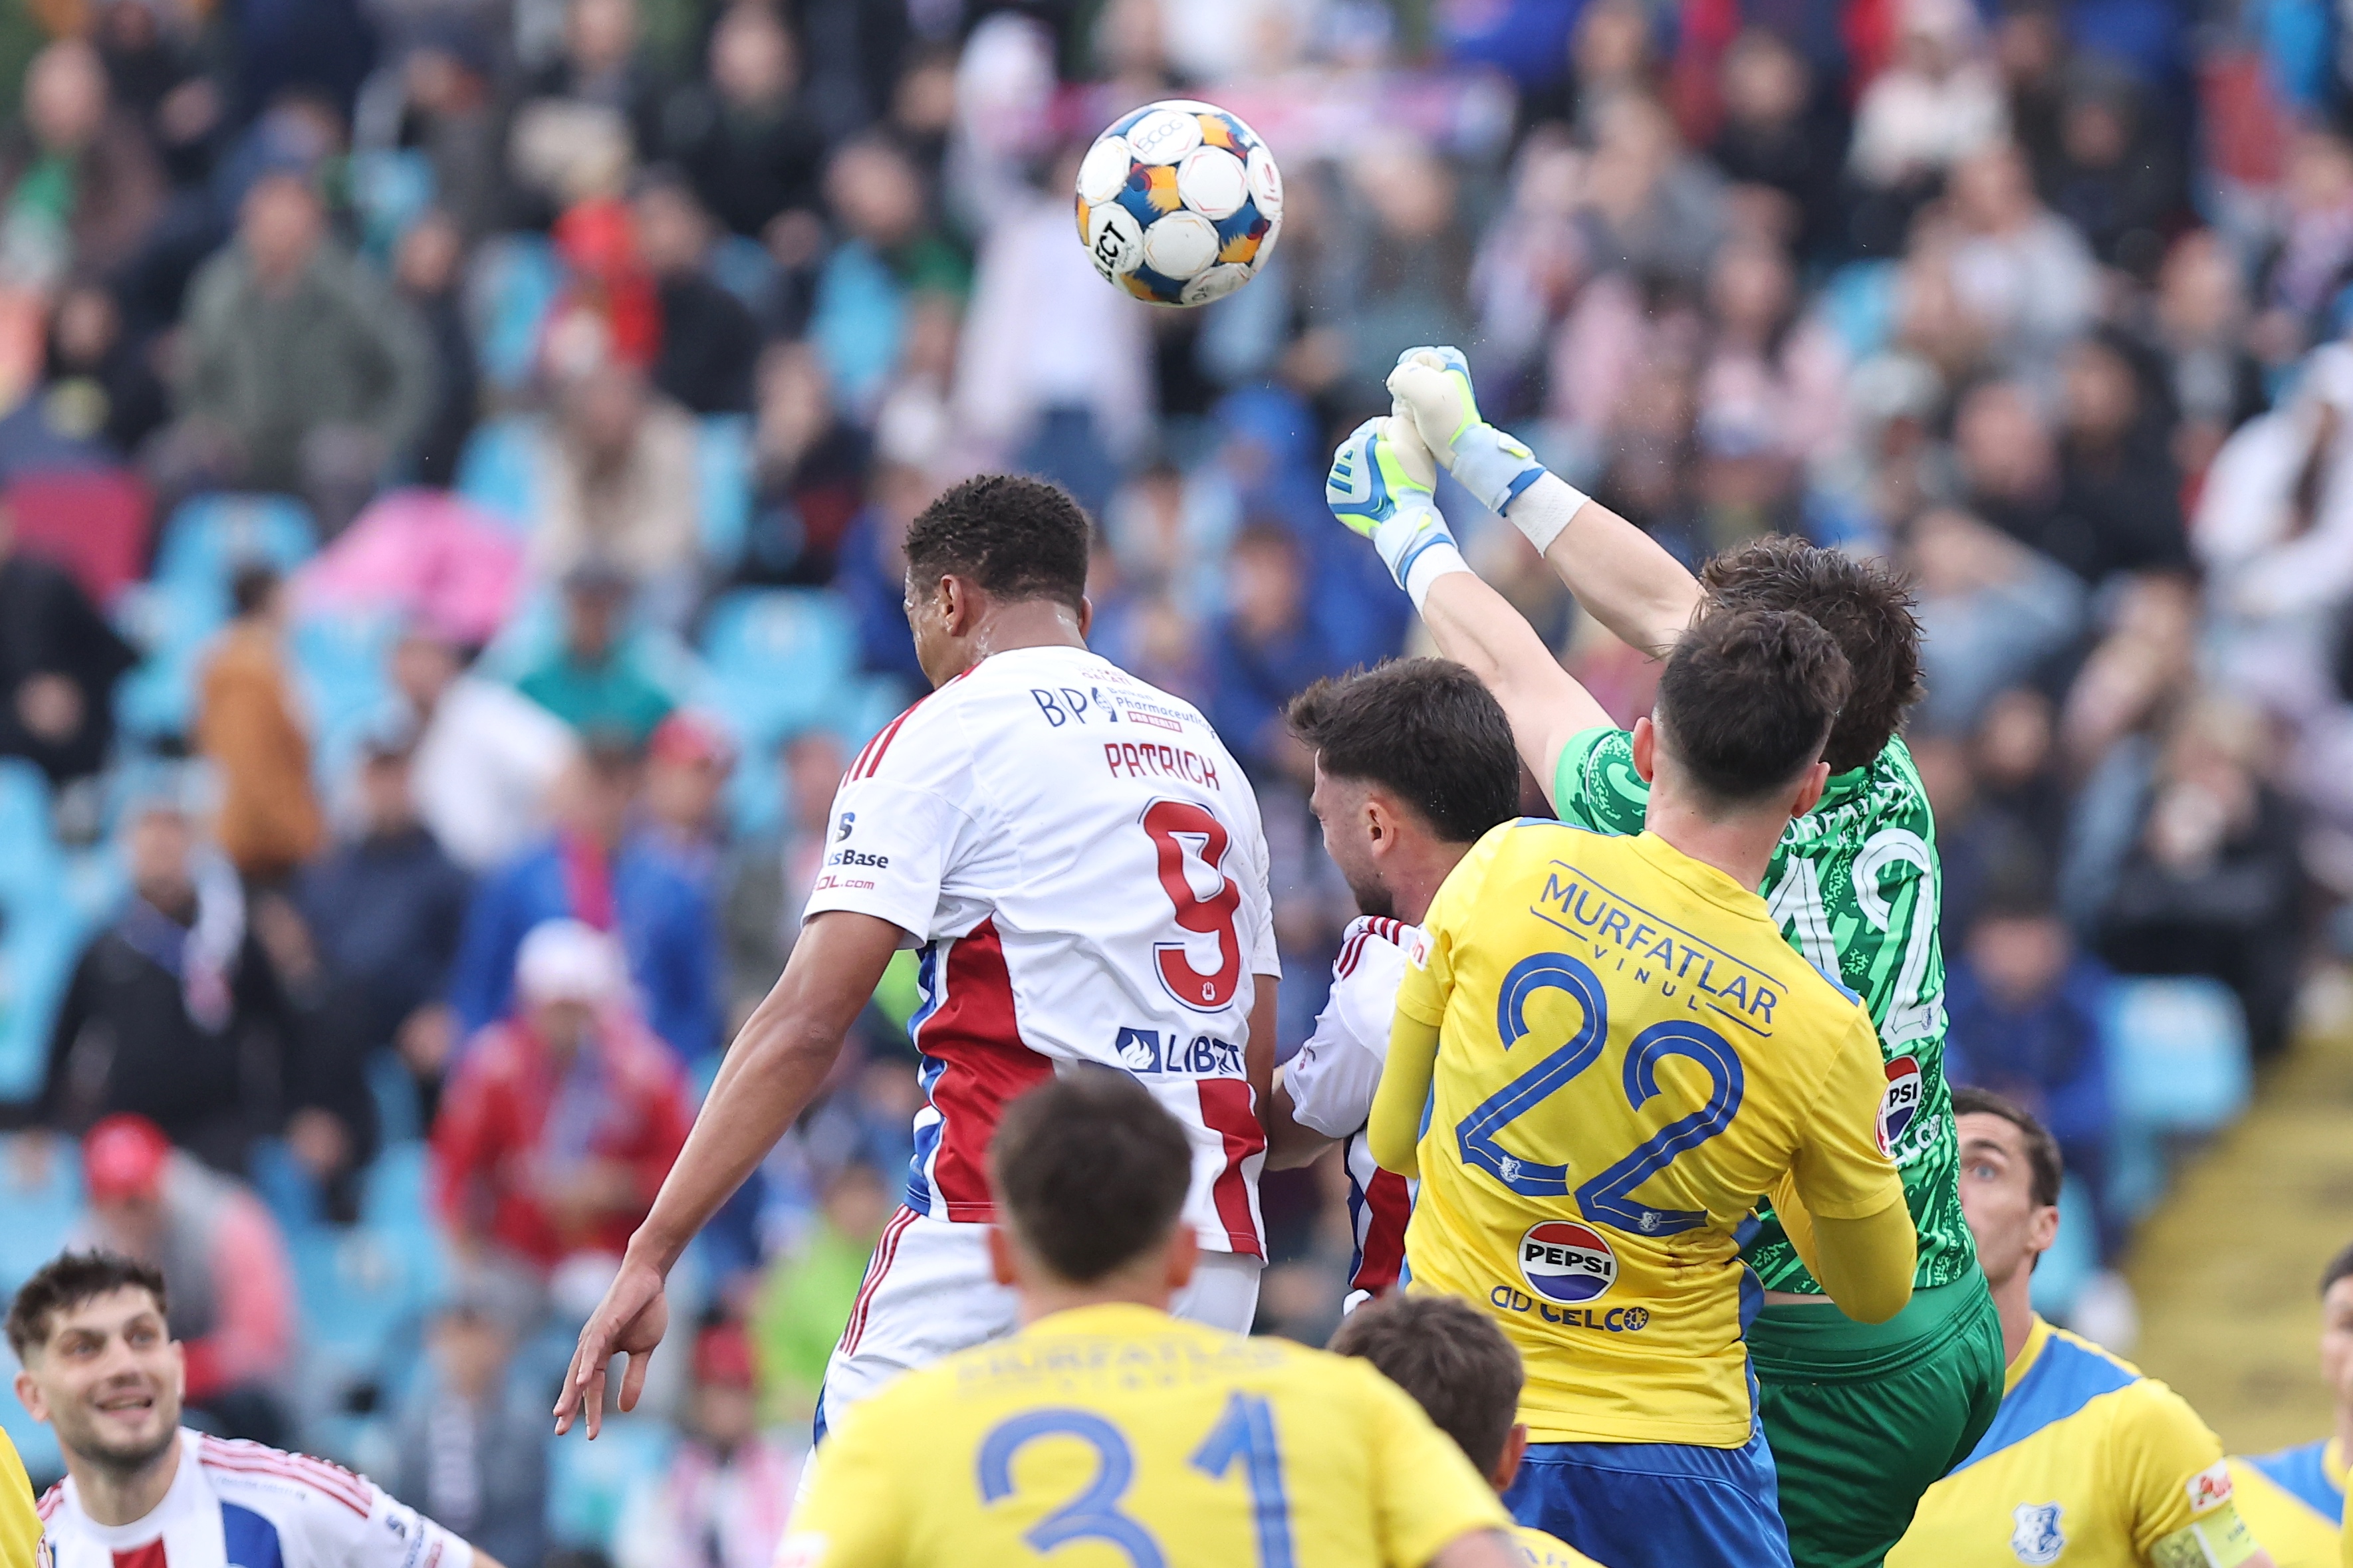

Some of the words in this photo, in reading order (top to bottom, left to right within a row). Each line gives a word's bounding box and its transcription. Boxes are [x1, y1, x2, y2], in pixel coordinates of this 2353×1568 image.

[1104, 742, 1220, 791] PATRICK
[1138, 795, 1242, 1014] 9
[1540, 873, 1777, 1024] MURFATLAR
[1594, 944, 1698, 1012] VINUL
[1455, 952, 1744, 1236] 22
[1525, 1243, 1611, 1276] PEPSI
[979, 1393, 1294, 1568] 31
